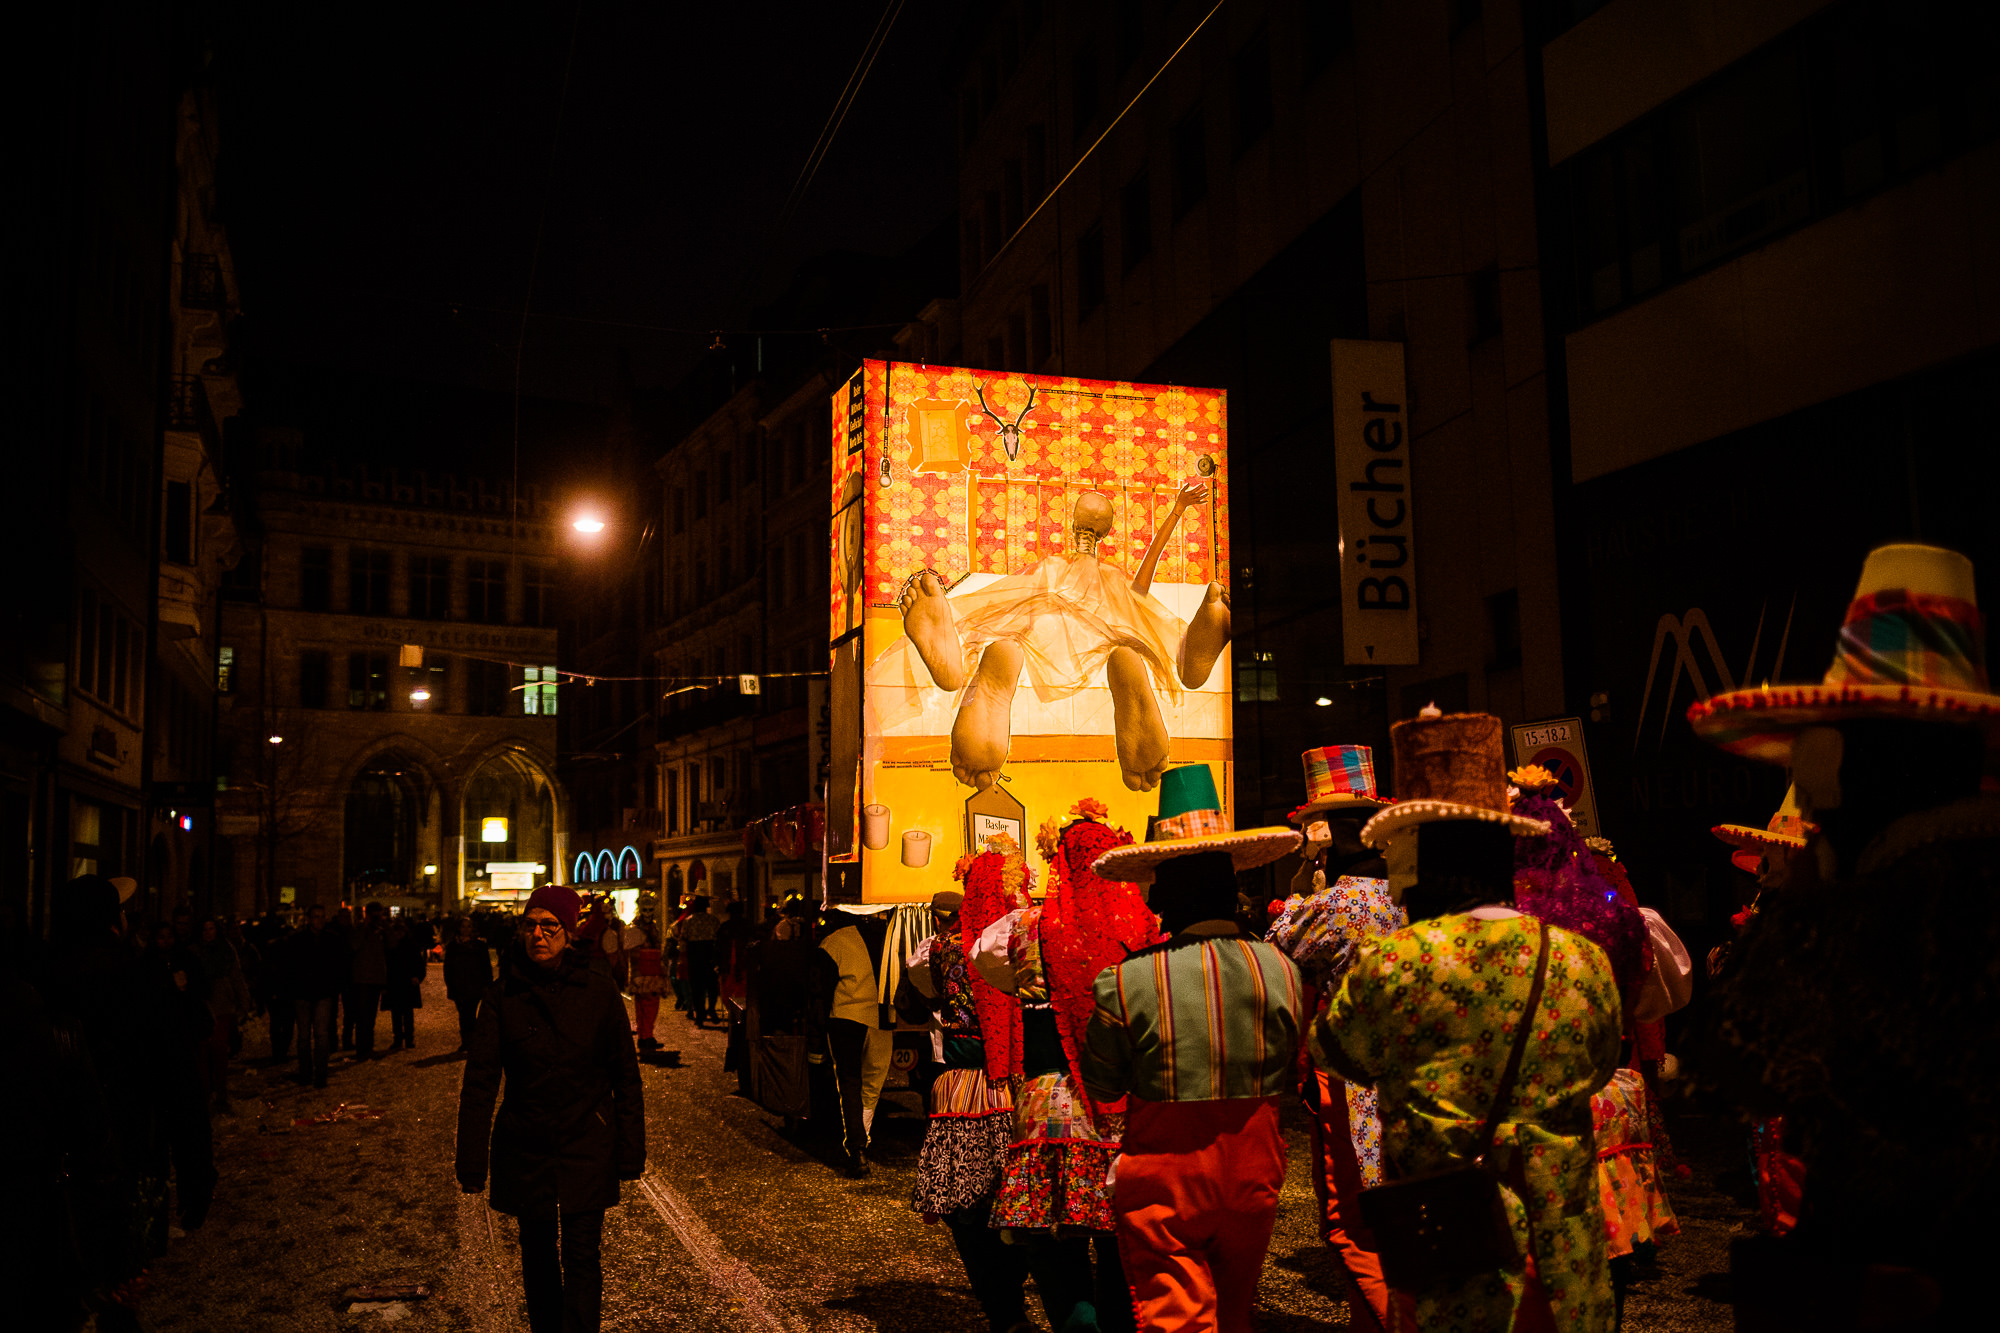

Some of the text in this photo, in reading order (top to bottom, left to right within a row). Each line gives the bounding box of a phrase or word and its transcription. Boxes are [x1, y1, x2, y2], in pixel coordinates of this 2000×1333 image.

[1350, 391, 1410, 611] Bücher
[363, 623, 416, 642] POST
[744, 679, 756, 691] 18
[985, 818, 1009, 832] Basler
[897, 1051, 910, 1063] 20
